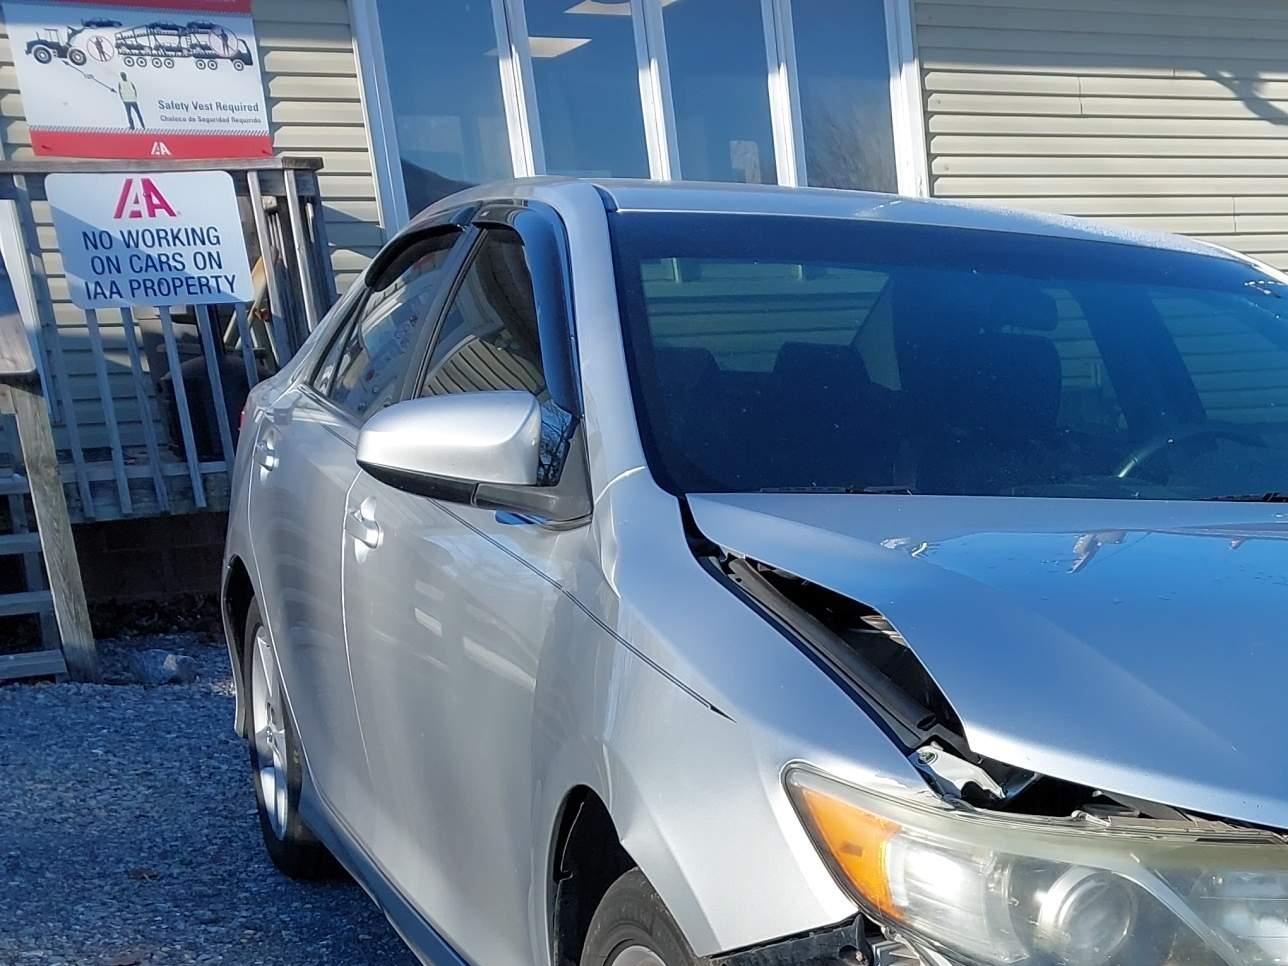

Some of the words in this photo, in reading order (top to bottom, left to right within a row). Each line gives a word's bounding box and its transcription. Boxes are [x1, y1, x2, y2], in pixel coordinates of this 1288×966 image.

[158, 99, 190, 113] Safety
[191, 101, 213, 112] Vest
[215, 102, 259, 114] Required
[82, 230, 112, 250] NO
[119, 226, 221, 247] WORKING
[90, 257, 122, 276] ON
[129, 254, 186, 274] CARS
[193, 251, 223, 270] ON
[84, 279, 125, 300] IAA
[130, 274, 237, 299] PROPERTY
